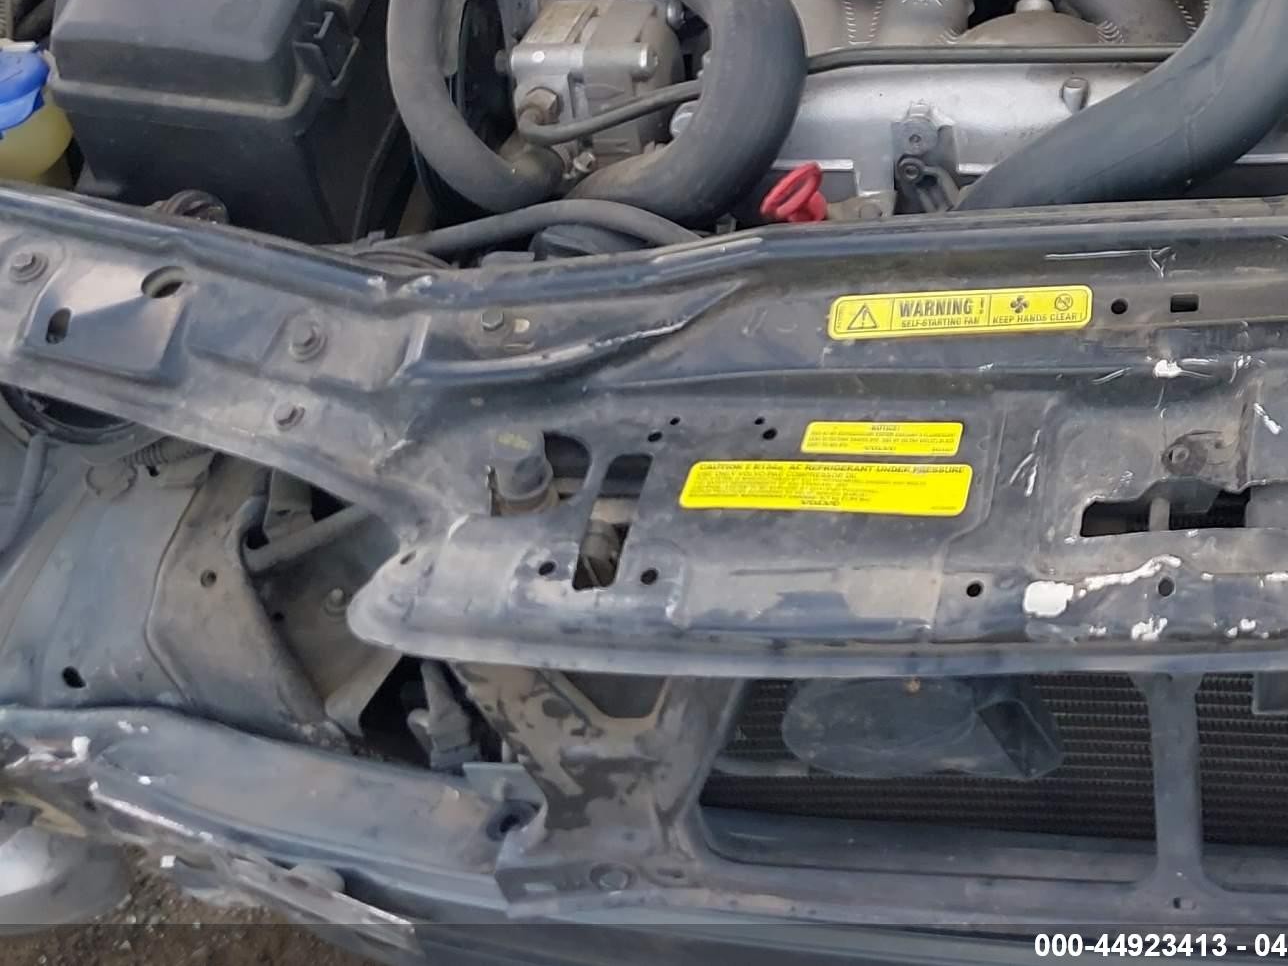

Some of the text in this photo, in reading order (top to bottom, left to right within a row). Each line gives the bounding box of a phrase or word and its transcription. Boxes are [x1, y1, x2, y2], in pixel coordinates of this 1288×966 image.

[900, 297, 973, 317] WARNING
[901, 316, 980, 328] SELF-STARTING FAN
[993, 314, 1014, 324] KEEP
[1017, 313, 1048, 323] HANDS
[1049, 312, 1078, 322] CLEAR
